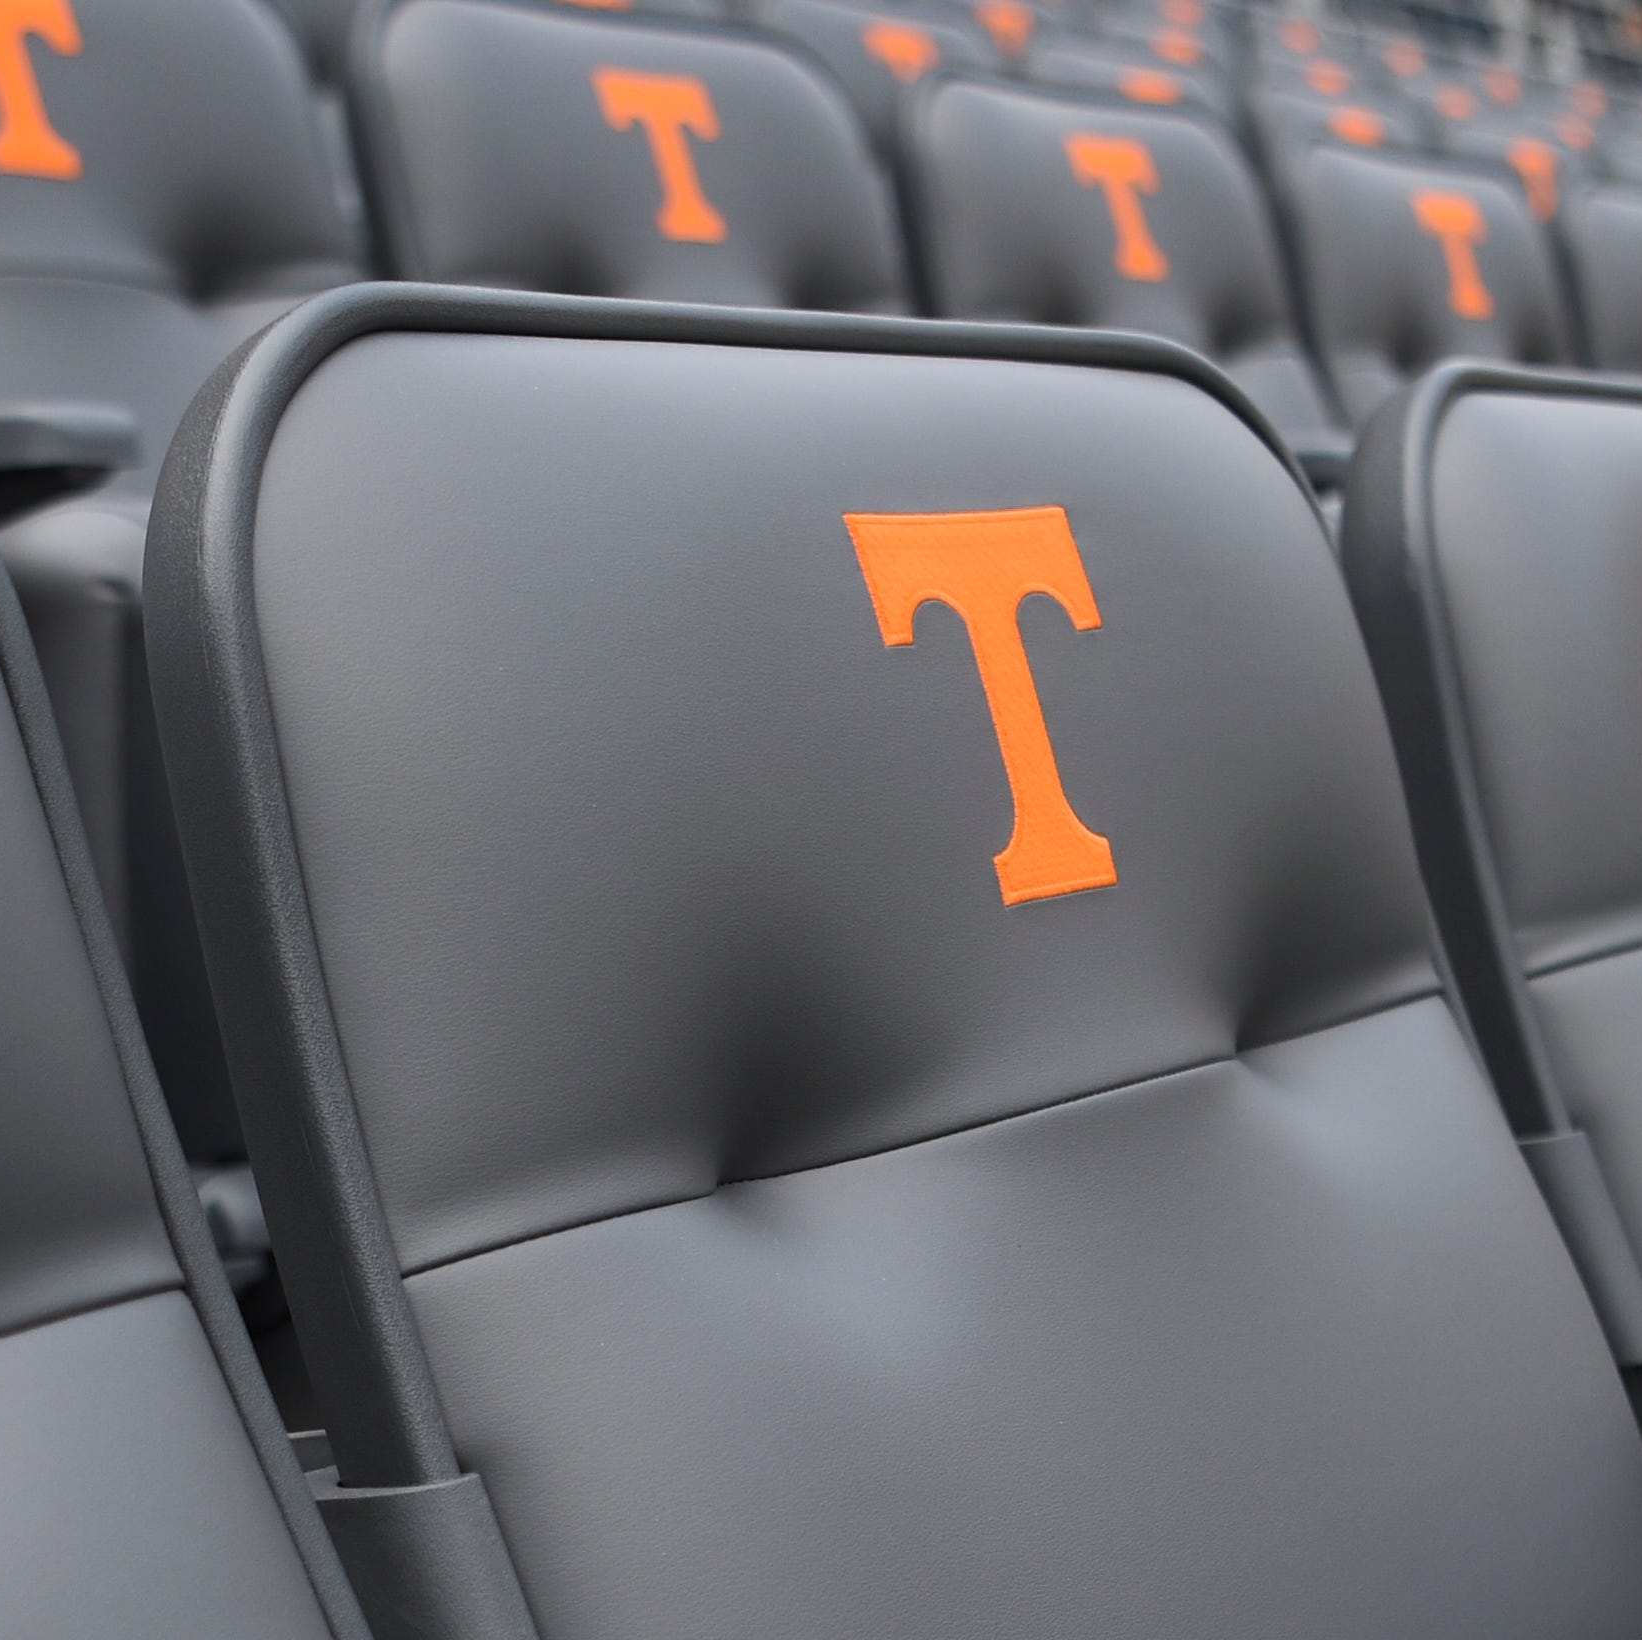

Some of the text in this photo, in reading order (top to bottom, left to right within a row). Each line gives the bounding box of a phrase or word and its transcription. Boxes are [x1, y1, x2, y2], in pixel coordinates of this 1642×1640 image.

[593, 65, 727, 243] T
[1065, 132, 1167, 281] T
[843, 504, 1119, 907] T
